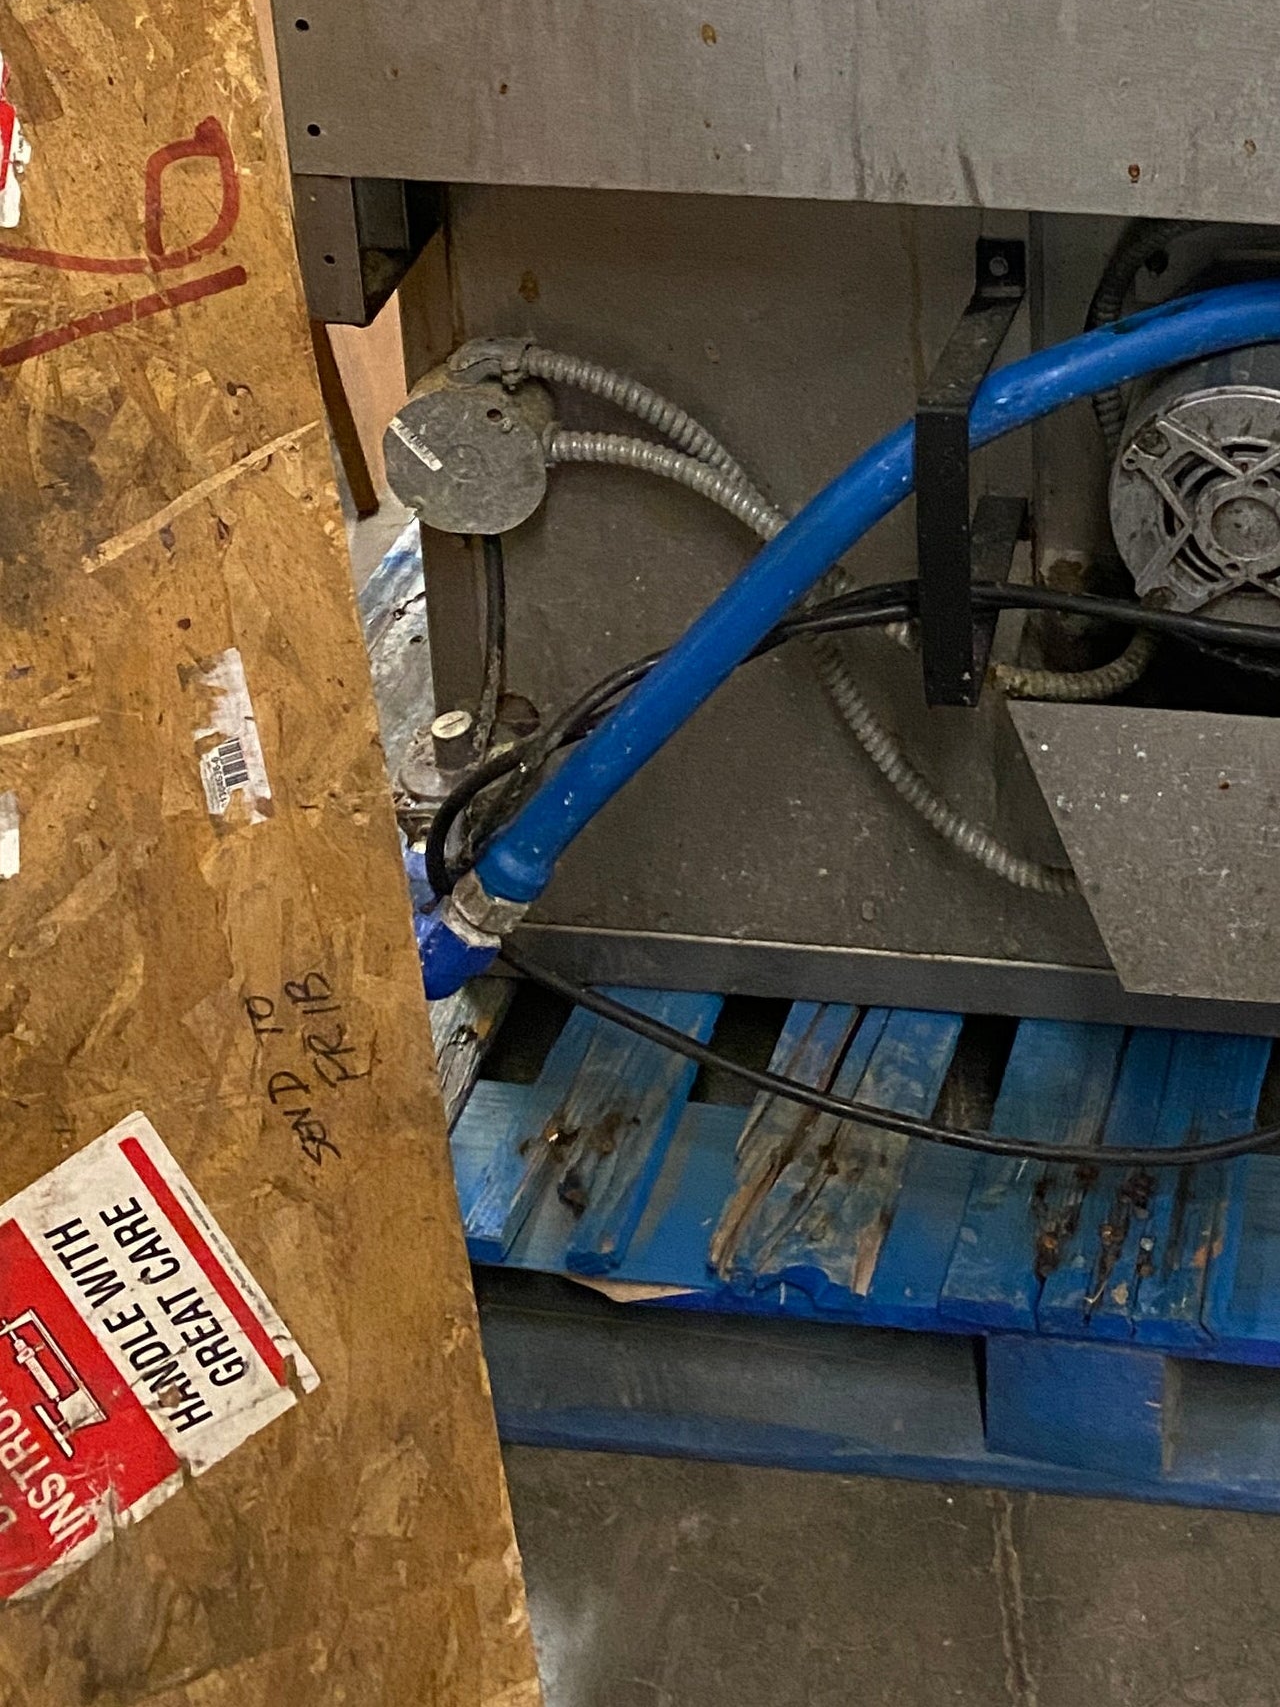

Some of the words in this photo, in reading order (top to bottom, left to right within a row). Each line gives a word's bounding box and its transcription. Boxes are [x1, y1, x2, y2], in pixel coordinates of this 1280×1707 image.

[267, 1070, 342, 1167] SEND
[43, 1217, 128, 1309] WITH
[98, 1196, 182, 1286] CARE
[102, 1302, 214, 1433] HANDLE
[156, 1286, 250, 1388] GREAT
[0, 1391, 93, 1543] INSTRU
